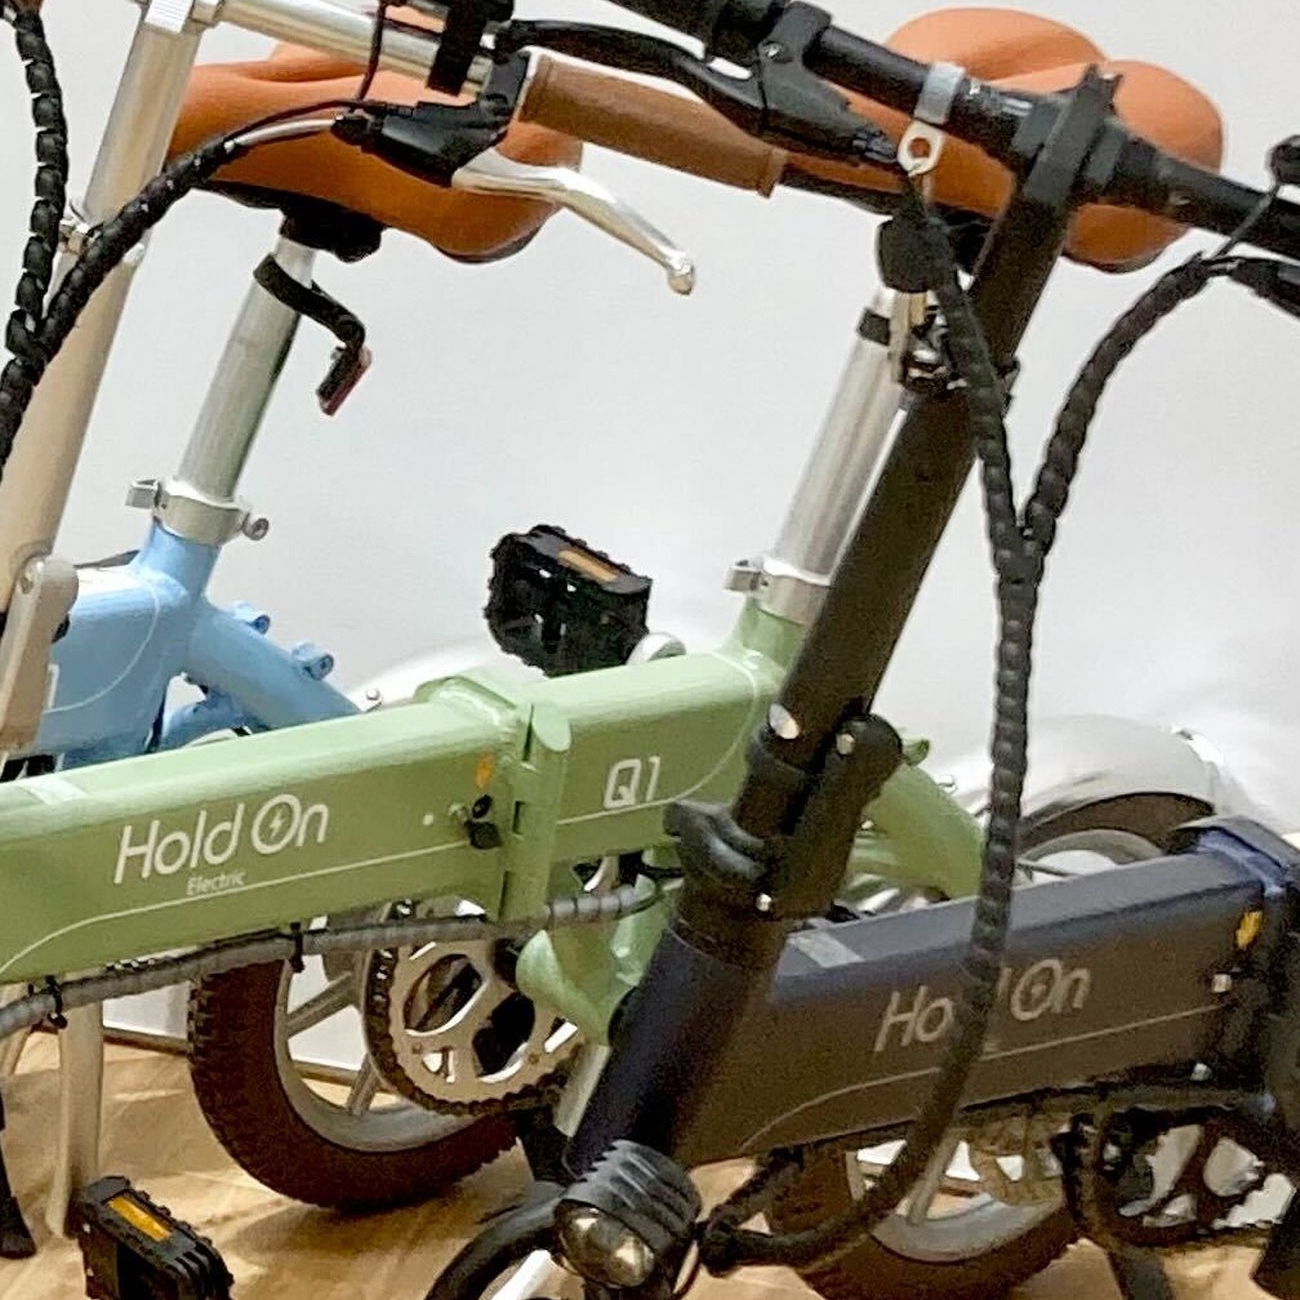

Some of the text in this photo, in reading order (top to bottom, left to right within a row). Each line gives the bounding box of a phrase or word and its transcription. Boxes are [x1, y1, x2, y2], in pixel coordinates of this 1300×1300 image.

[603, 756, 662, 810] Q1
[113, 793, 330, 885] Hold On
[185, 868, 247, 898] Electric
[1010, 958, 1092, 1022] On
